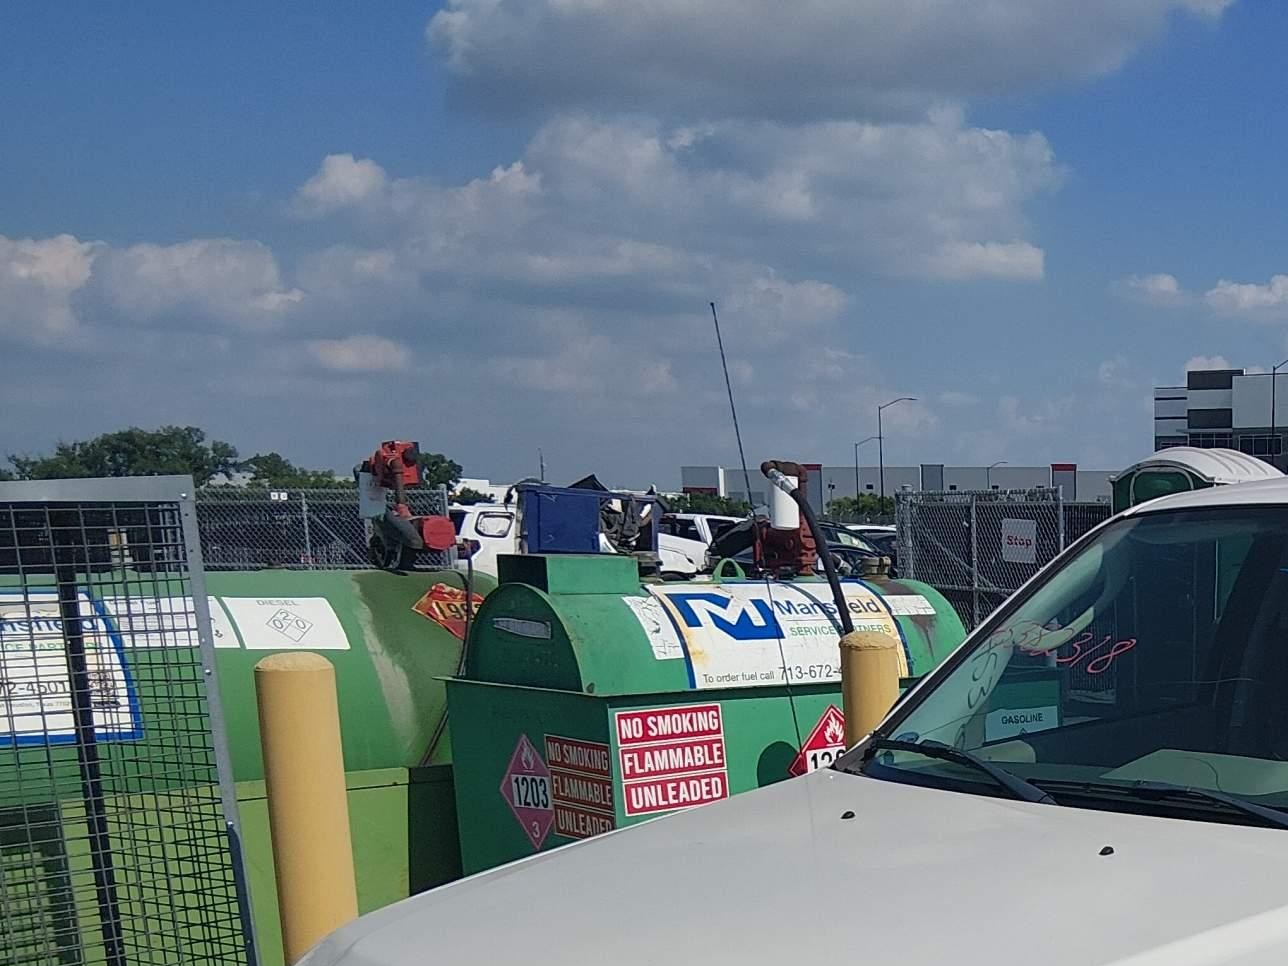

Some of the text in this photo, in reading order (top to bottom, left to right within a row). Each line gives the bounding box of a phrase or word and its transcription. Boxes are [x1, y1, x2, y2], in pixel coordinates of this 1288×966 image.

[1007, 535, 1032, 548] Stop
[773, 599, 882, 615] Manseld
[790, 625, 836, 637] SERVICE
[703, 673, 714, 683] To
[716, 672, 740, 682] order
[742, 671, 758, 681] fuel
[760, 671, 775, 680] call
[620, 710, 719, 739] NO SMOKING
[1001, 713, 1044, 725] GASOLINE
[549, 741, 609, 771] NO SMOKING
[624, 743, 723, 775] FLAMMABLE
[514, 777, 549, 809] 1203
[552, 775, 612, 806] FLAMMABLE
[631, 777, 723, 809] UNLEADED
[532, 821, 541, 838] 3
